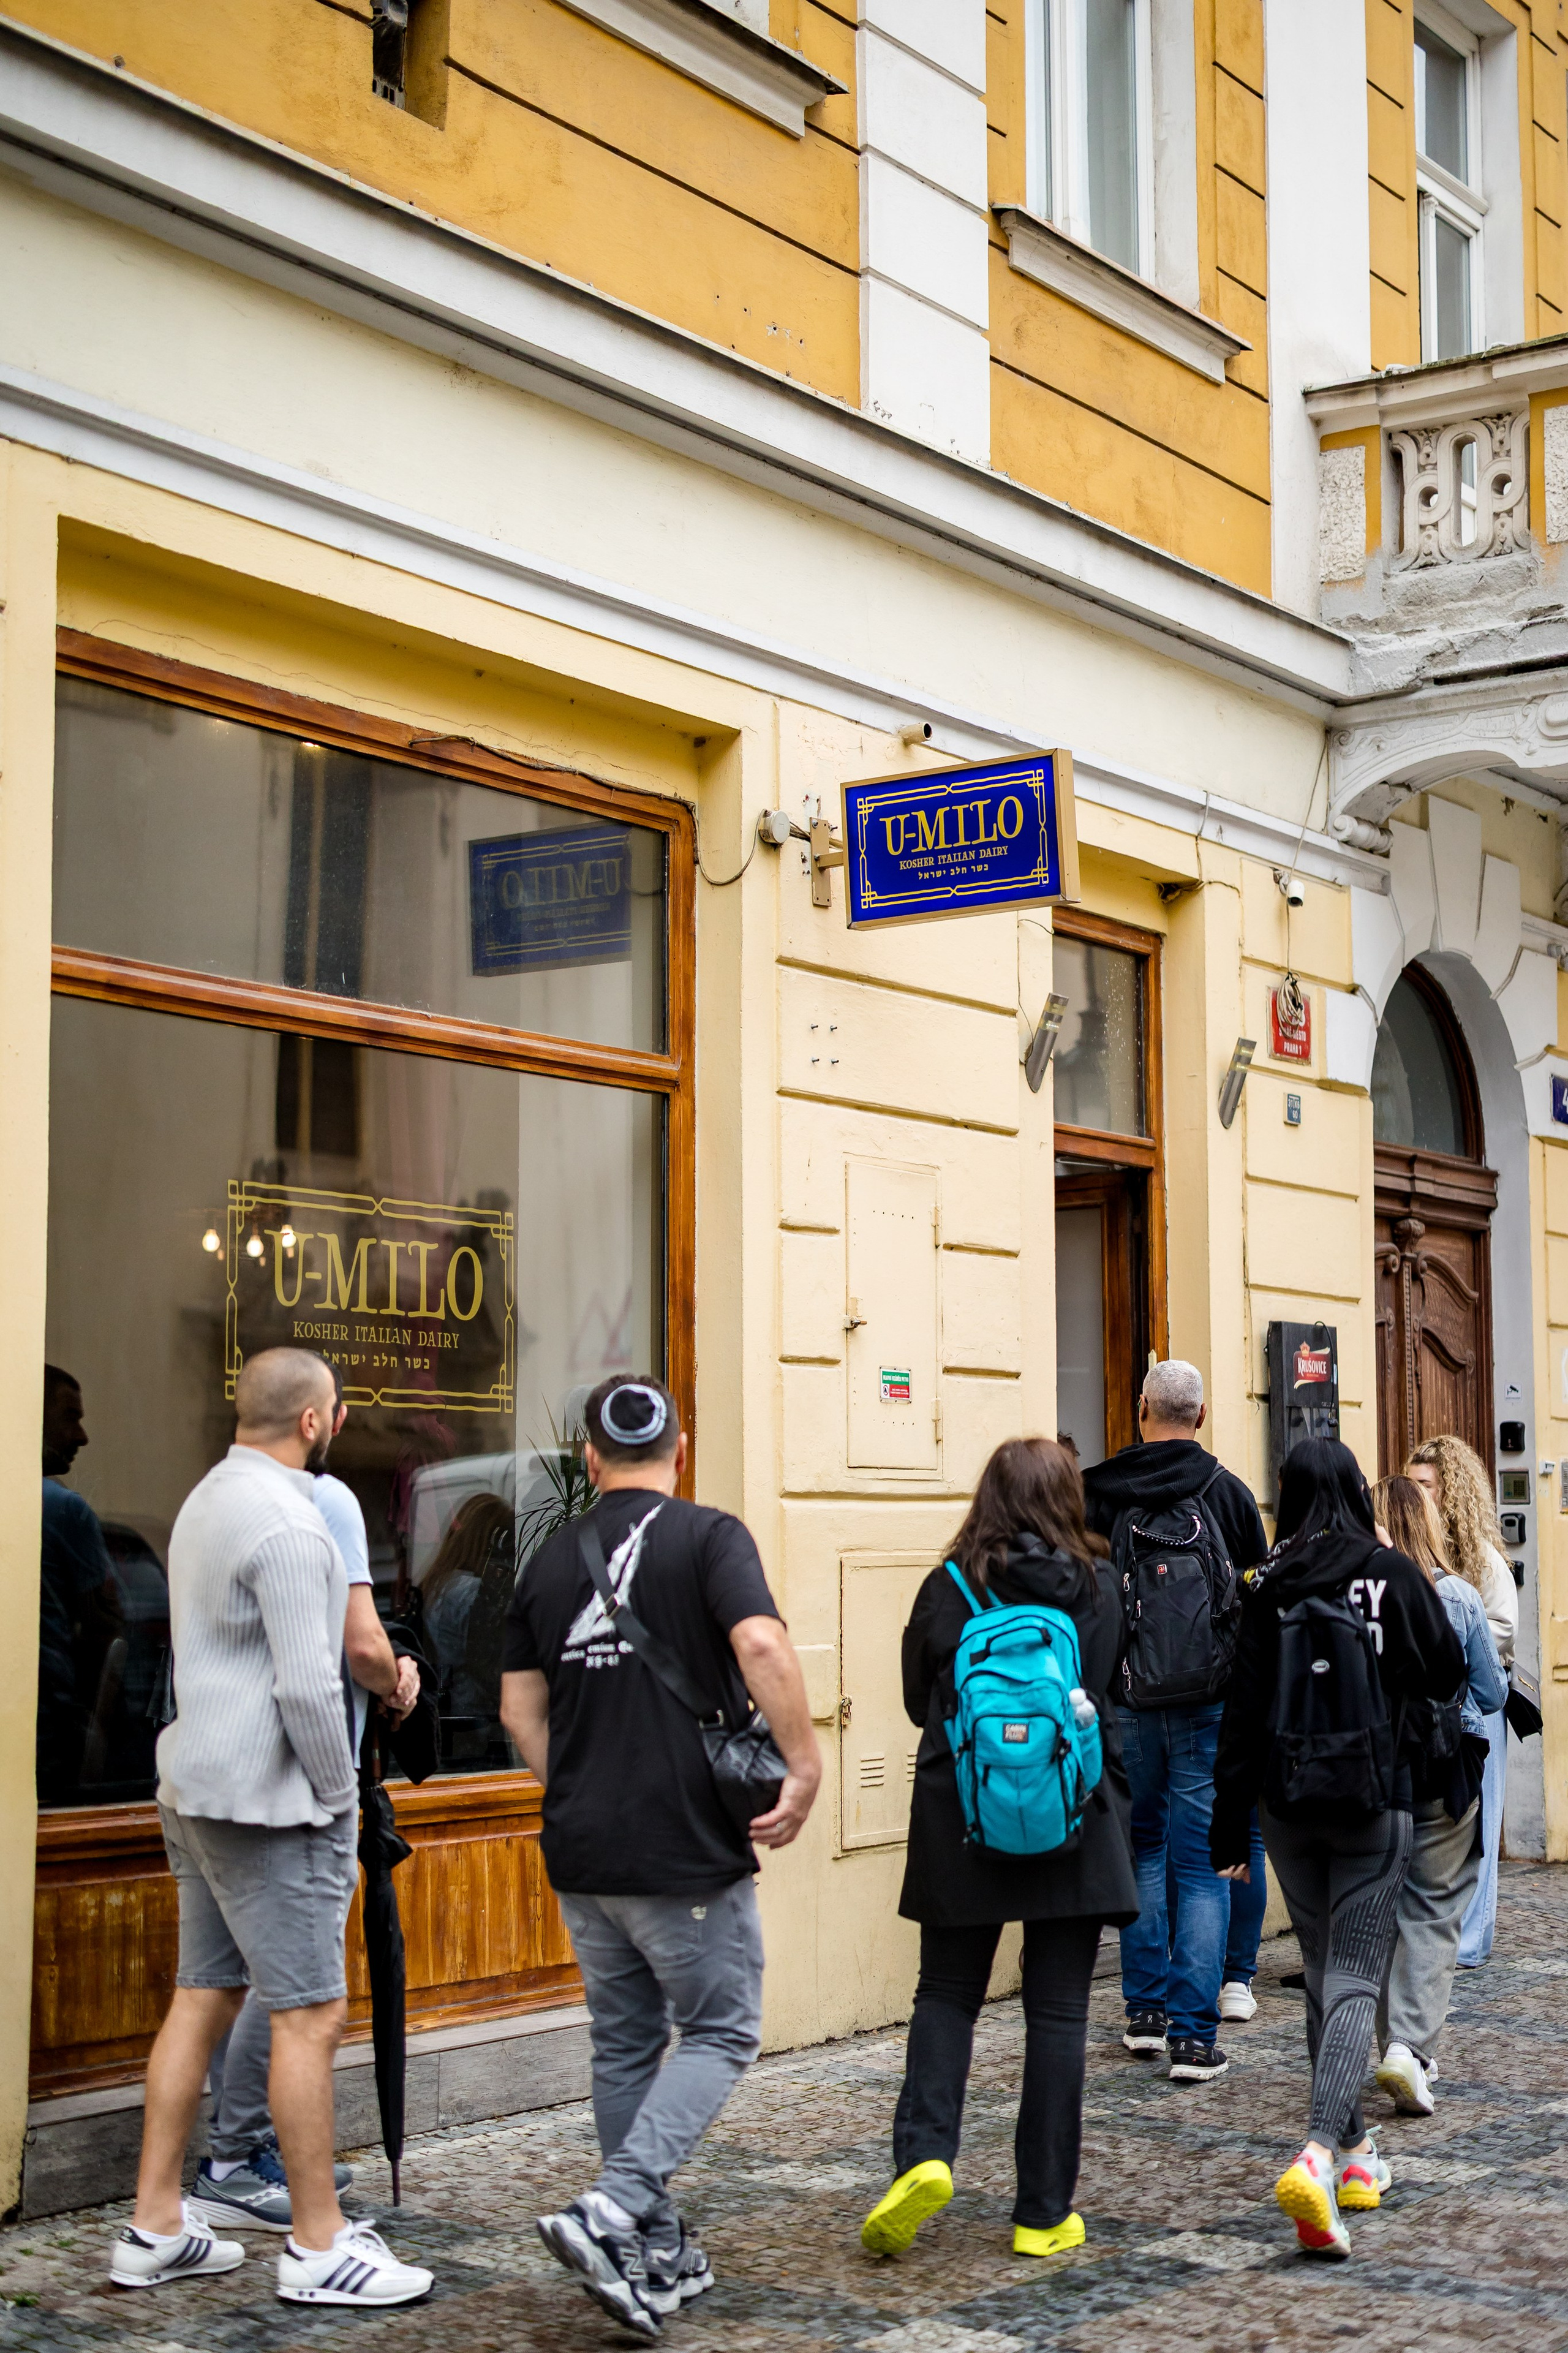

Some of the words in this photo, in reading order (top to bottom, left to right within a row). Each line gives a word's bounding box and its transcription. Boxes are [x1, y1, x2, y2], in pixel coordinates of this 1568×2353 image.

[880, 796, 1023, 856] U-MILO
[899, 856, 935, 870] KOSHER
[938, 850, 976, 864] ITALIAN
[979, 846, 1008, 858] DAIRY
[918, 869, 946, 880] ישראל
[950, 866, 967, 875] חלב
[971, 864, 989, 872] כשר
[1284, 1041, 1298, 1054] PRAHA
[1299, 1044, 1302, 1056] 1
[264, 1229, 484, 1321] U-MILO
[293, 1321, 349, 1340] KOSHER
[355, 1326, 412, 1345] ITALIAN
[418, 1331, 459, 1348] DAIRY
[373, 1352, 398, 1367] חלב
[405, 1356, 430, 1369] כשר
[1297, 1357, 1327, 1377] KRUŠOVICE
